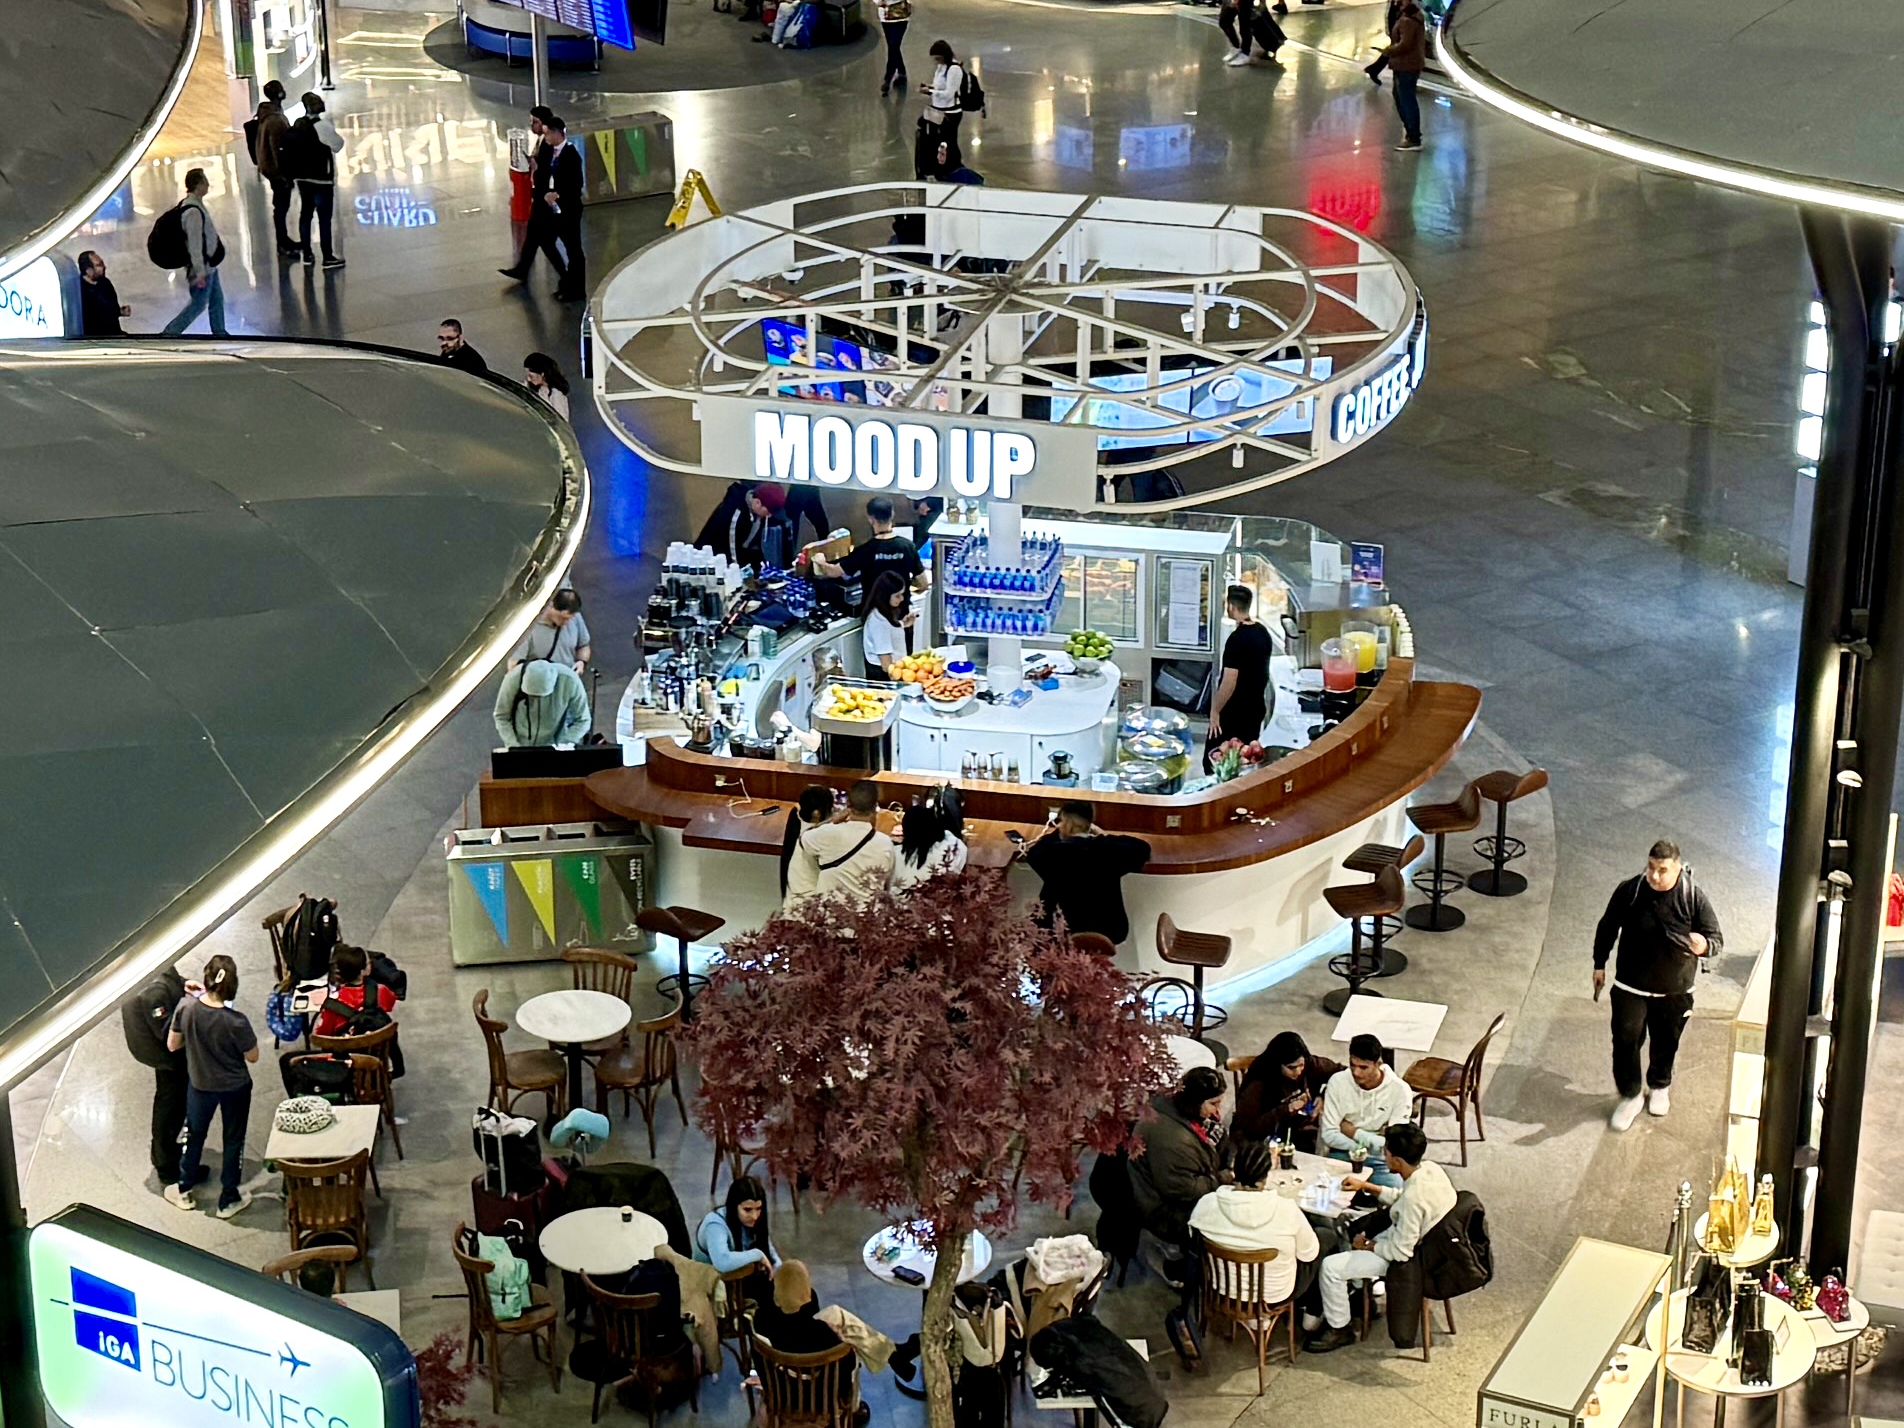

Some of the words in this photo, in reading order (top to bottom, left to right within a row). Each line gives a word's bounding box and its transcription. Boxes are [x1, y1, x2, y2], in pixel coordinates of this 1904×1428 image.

[1337, 353, 1412, 444] COFFEE
[754, 410, 940, 494] MOOD
[950, 425, 1037, 500] UP
